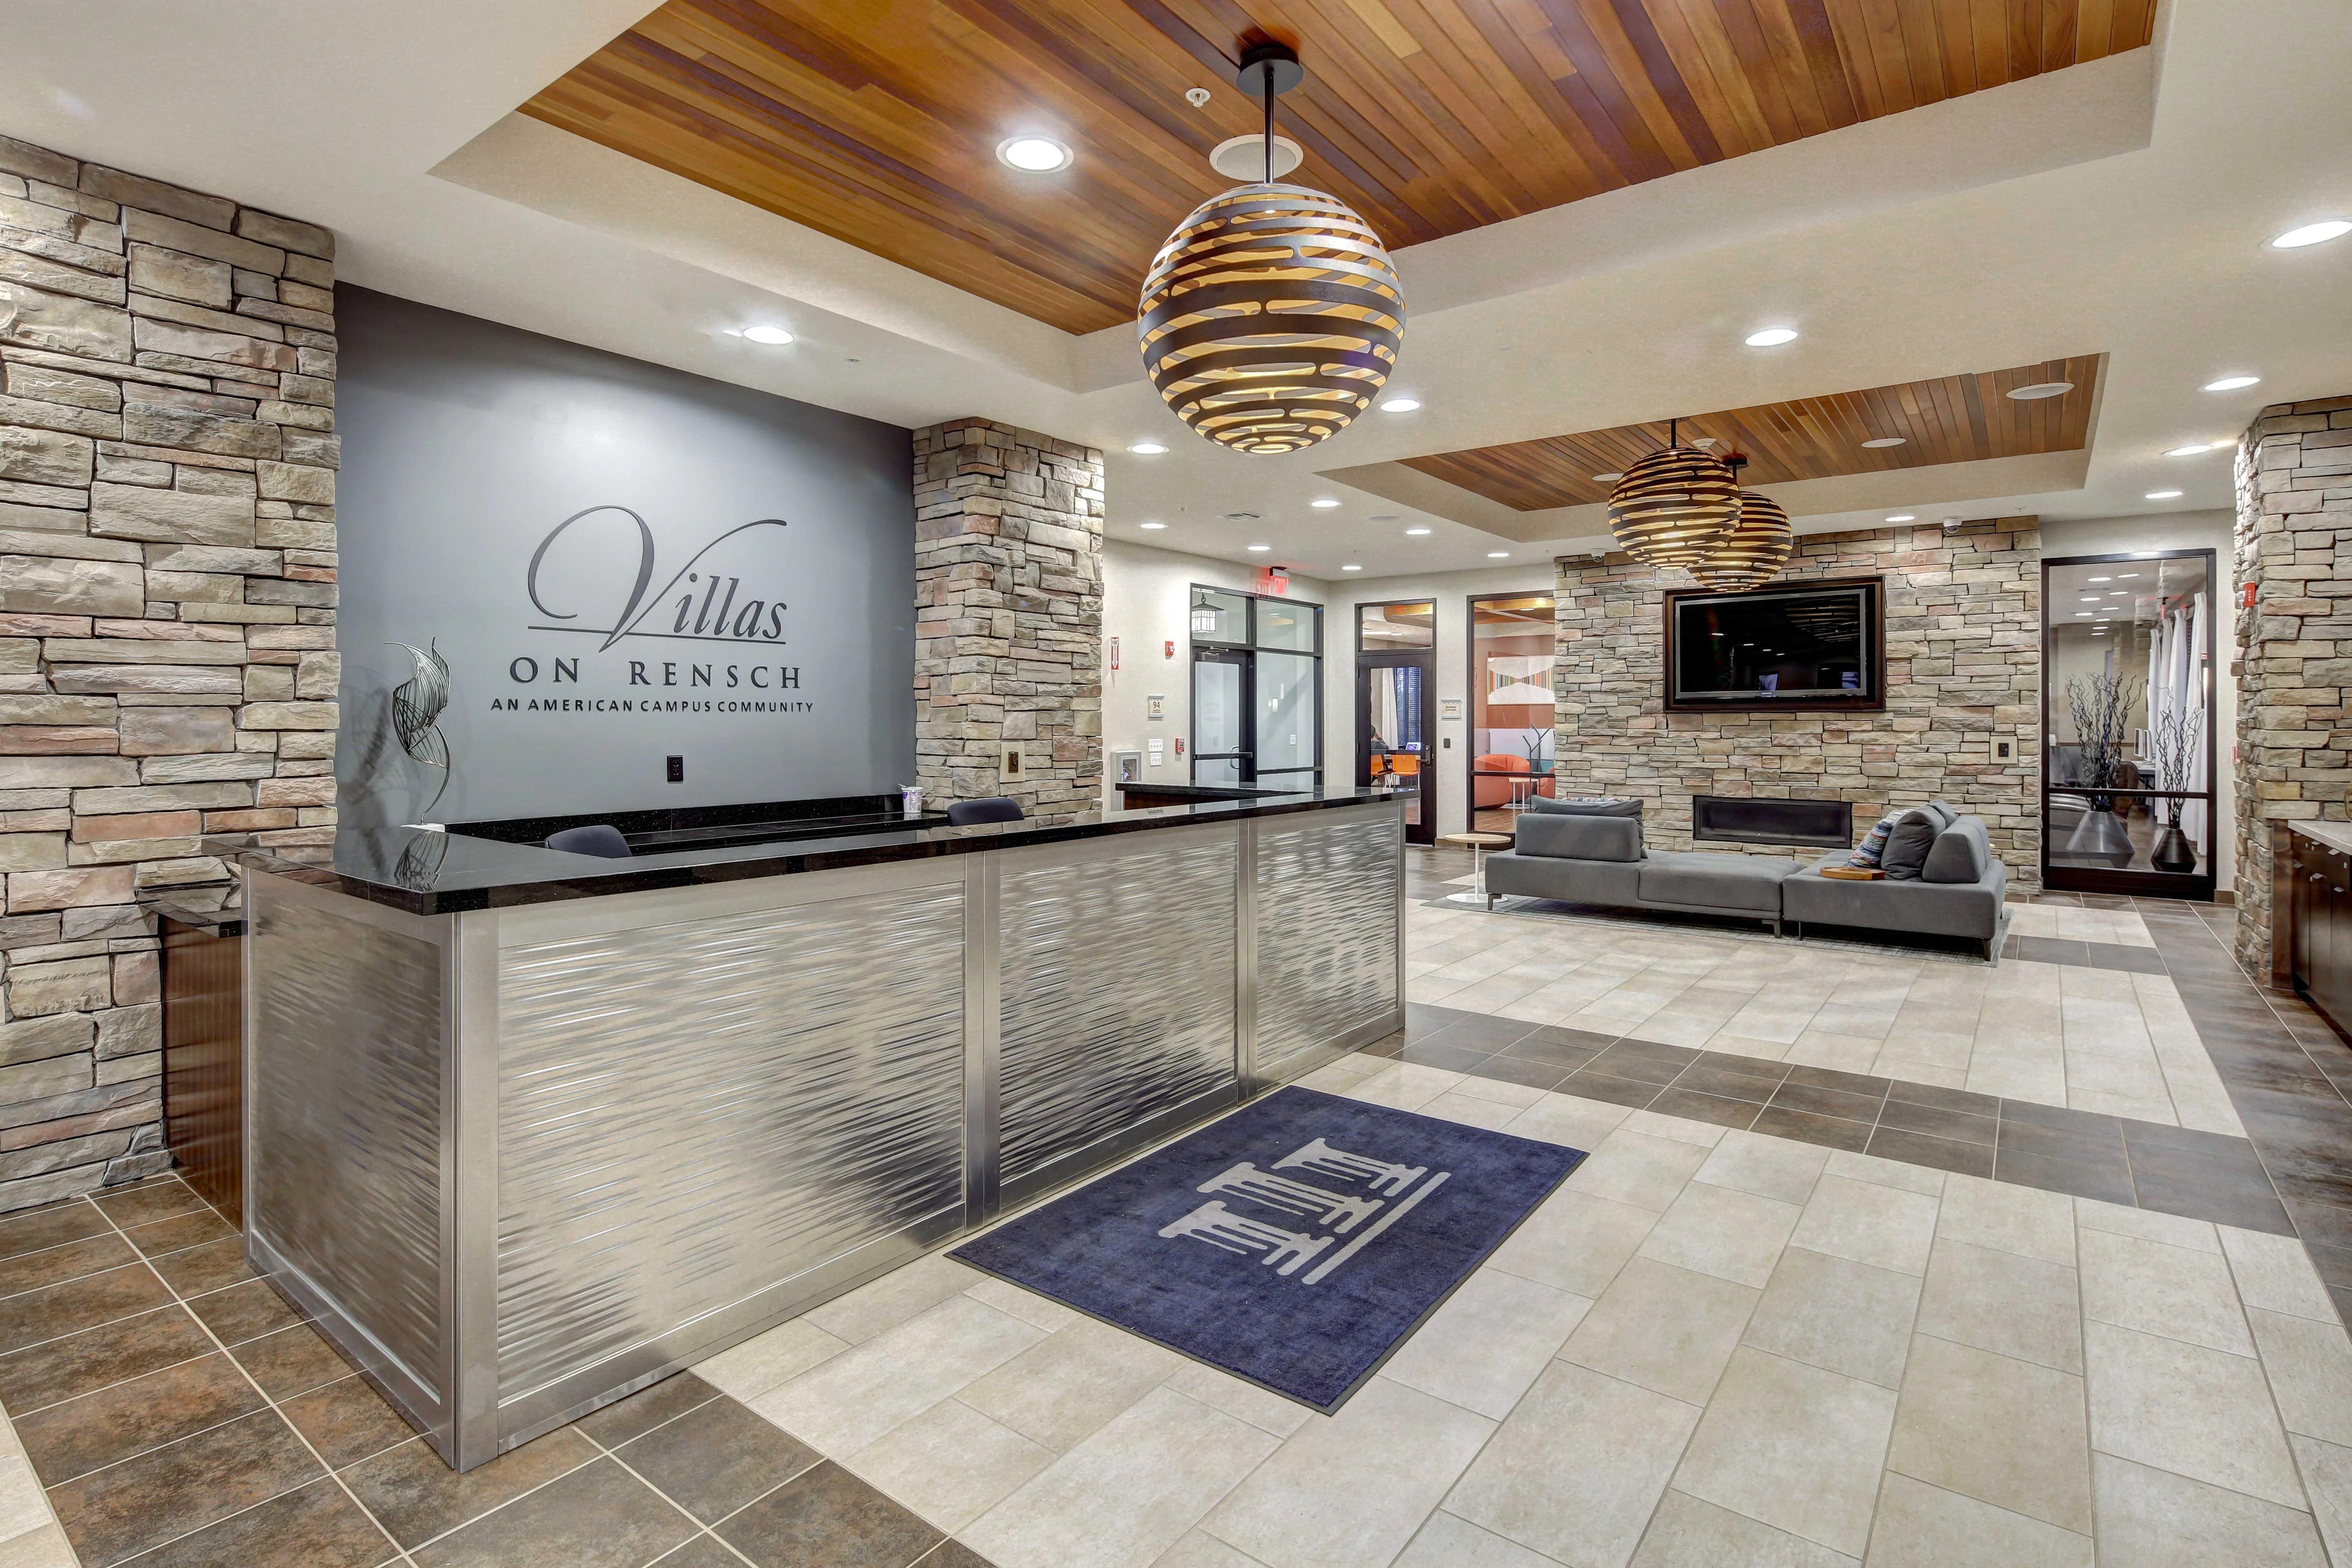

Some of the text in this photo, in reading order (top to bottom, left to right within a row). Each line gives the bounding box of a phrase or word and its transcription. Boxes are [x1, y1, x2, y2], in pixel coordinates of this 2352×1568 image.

[528, 505, 787, 653] Villas
[509, 657, 800, 689] ON RENSCH
[490, 698, 814, 713] AN AMERICAN CAMPUS COMMUNITY
